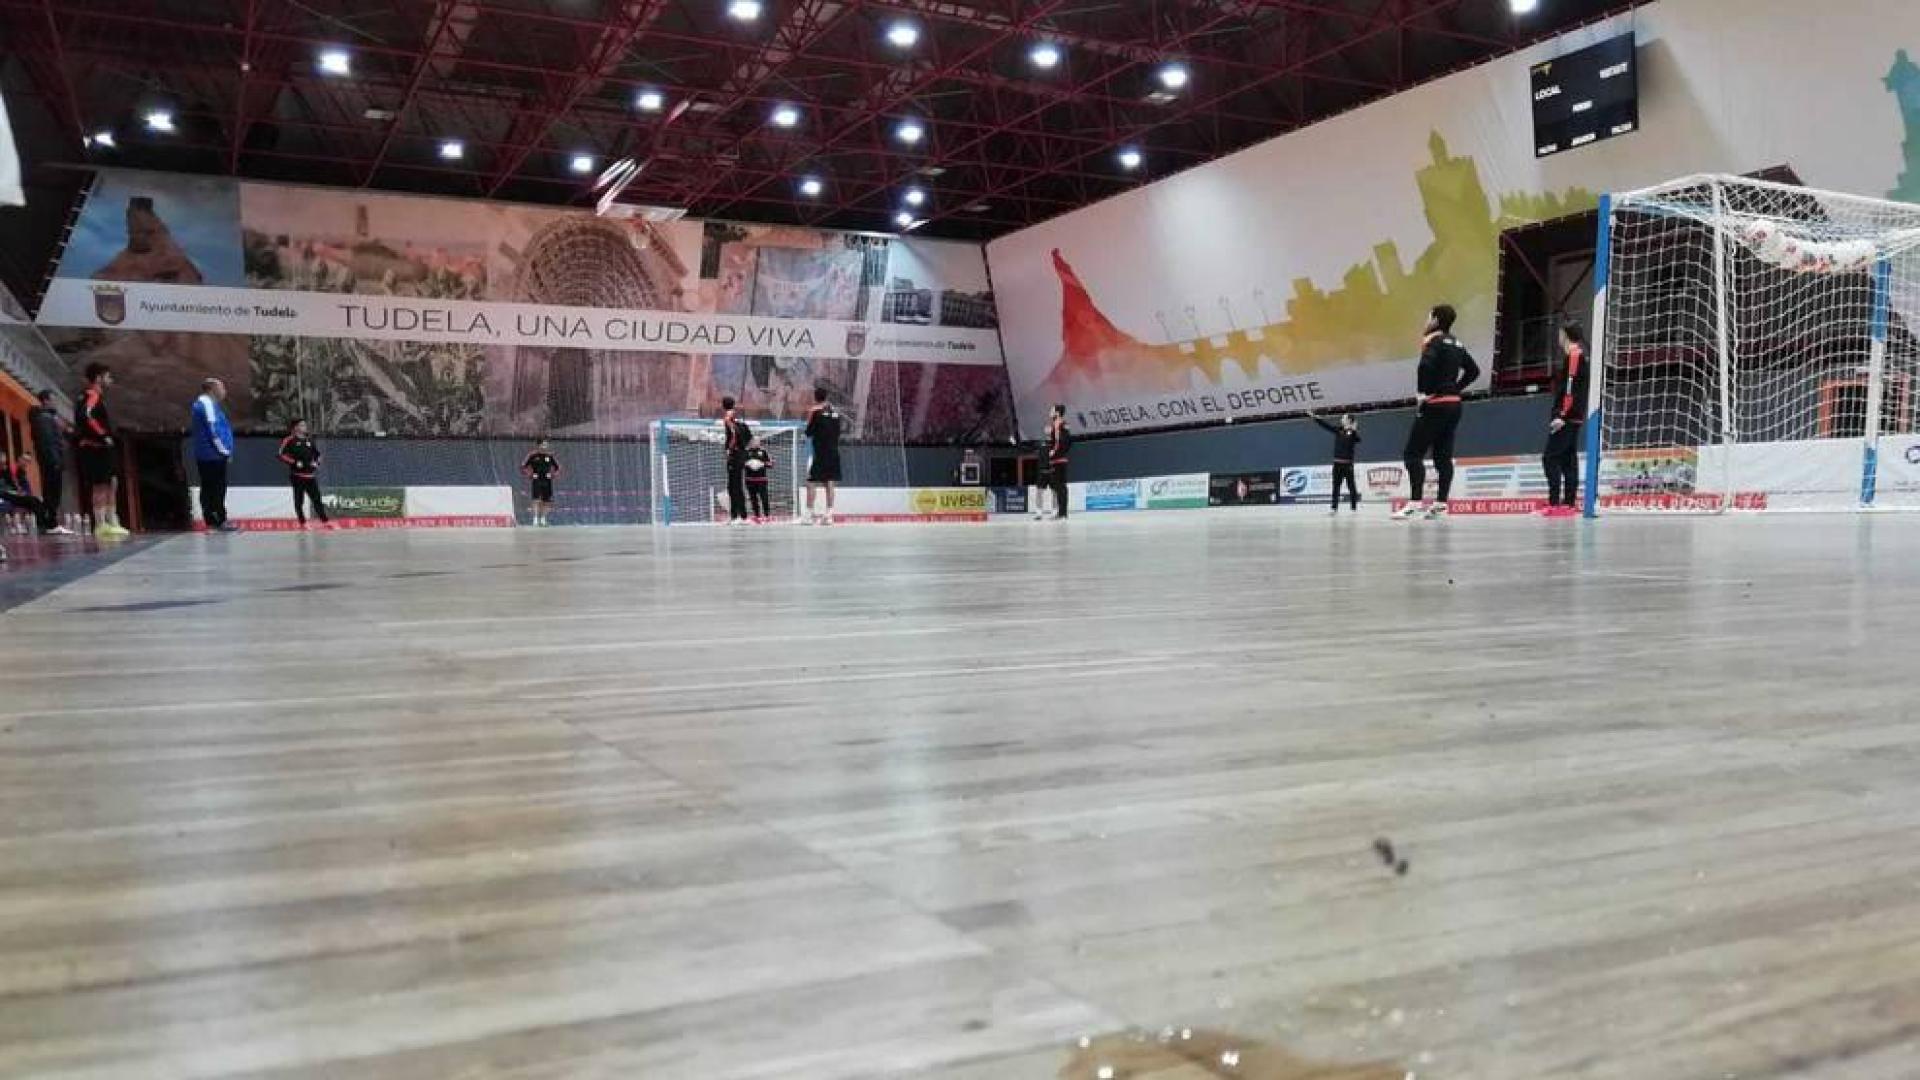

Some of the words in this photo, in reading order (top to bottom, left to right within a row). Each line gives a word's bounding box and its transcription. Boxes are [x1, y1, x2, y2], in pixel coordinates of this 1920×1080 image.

[1535, 85, 1561, 100] LOCAL
[139, 300, 231, 316] Ayuntamiento
[234, 305, 250, 316] de
[253, 305, 299, 318] Tudela
[338, 304, 501, 337] TUDELA,
[517, 313, 592, 338] UNA
[604, 318, 736, 344] CIUDAD
[748, 325, 815, 349] VIVA
[1157, 399, 1198, 419] CON
[1200, 396, 1225, 413] EL
[1227, 381, 1325, 411] DEPORTE
[940, 493, 985, 508] uvesa
[1452, 501, 1473, 513] CON
[1475, 501, 1488, 512] EL
[1490, 501, 1537, 512] DEPORTE
